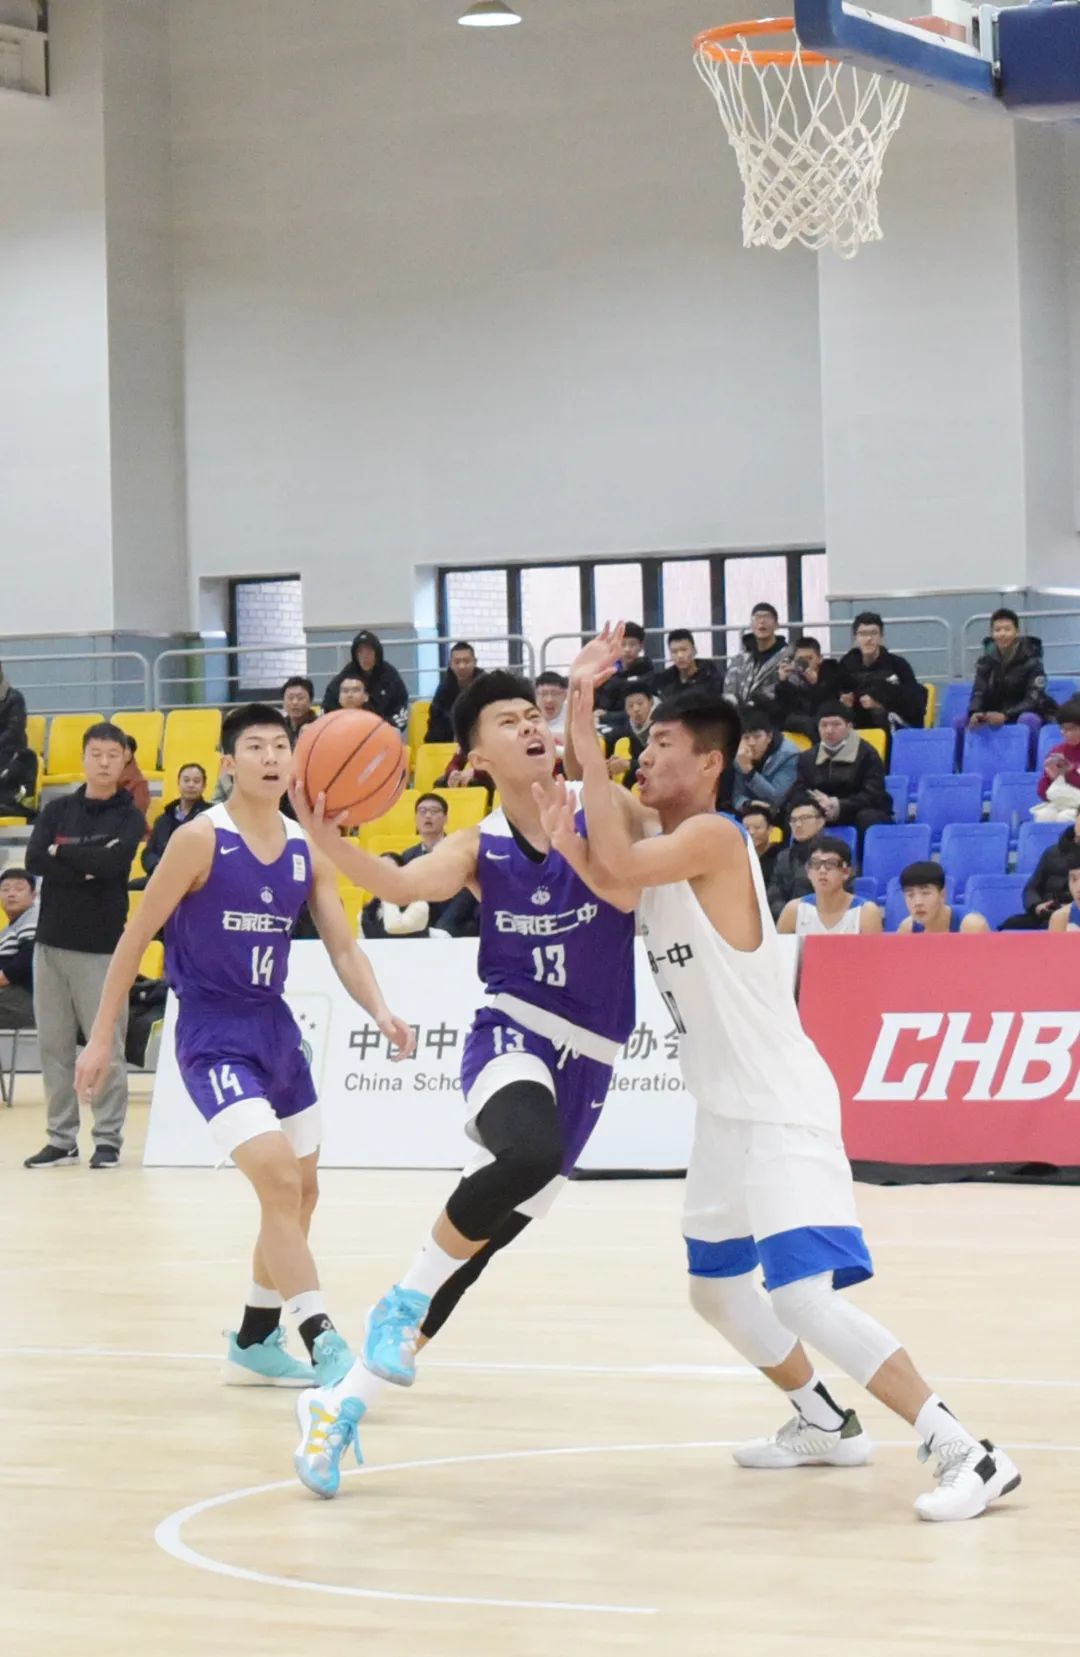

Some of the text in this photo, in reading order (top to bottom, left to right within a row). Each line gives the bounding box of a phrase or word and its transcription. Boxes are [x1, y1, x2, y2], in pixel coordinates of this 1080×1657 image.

[493, 903, 598, 936] 石家庄二中
[251, 946, 274, 986] 14
[532, 944, 567, 987] 13
[492, 1025, 526, 1054] 13
[852, 1012, 1080, 1100] CHB
[208, 1064, 244, 1105] 14
[344, 1072, 403, 1091] China
[608, 1073, 686, 1091] deratio
